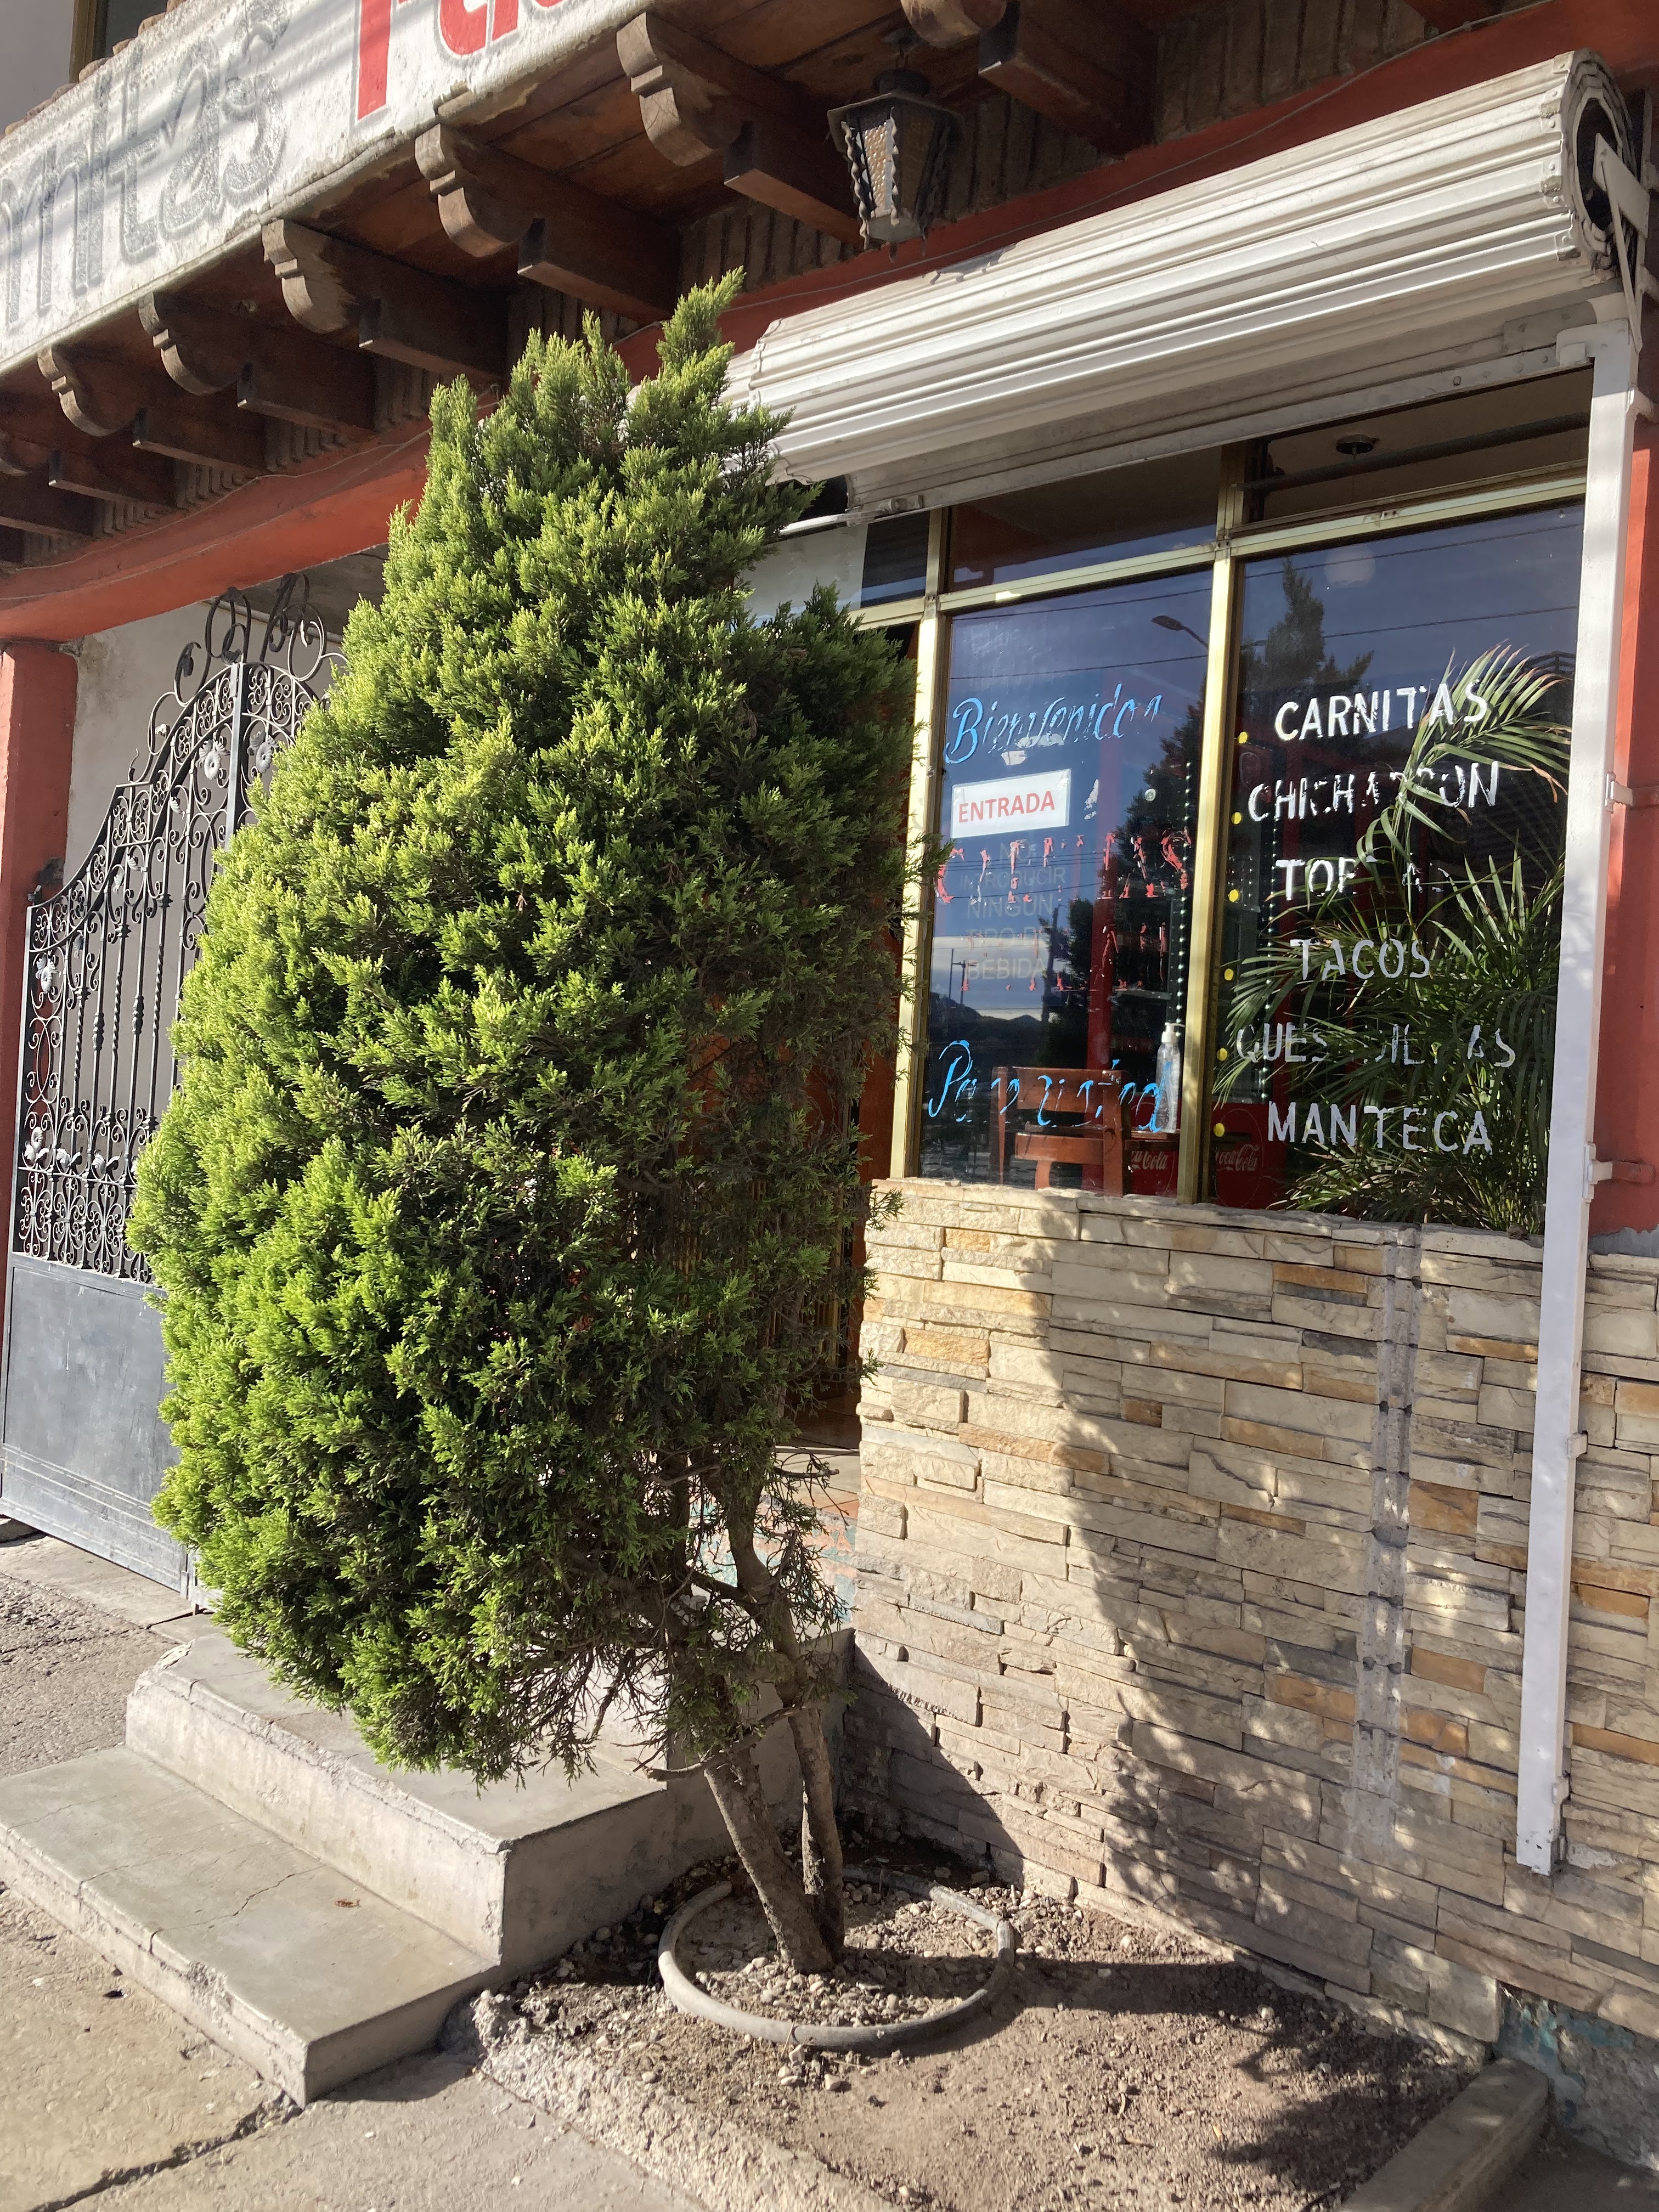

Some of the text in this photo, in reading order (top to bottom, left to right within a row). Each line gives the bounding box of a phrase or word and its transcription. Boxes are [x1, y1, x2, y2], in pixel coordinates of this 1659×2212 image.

[1274, 679, 1488, 742] CARNITAS
[958, 791, 1055, 823] ENTRADA
[1290, 936, 1430, 980] TACOS
[1268, 1101, 1492, 1155] MANTECA
